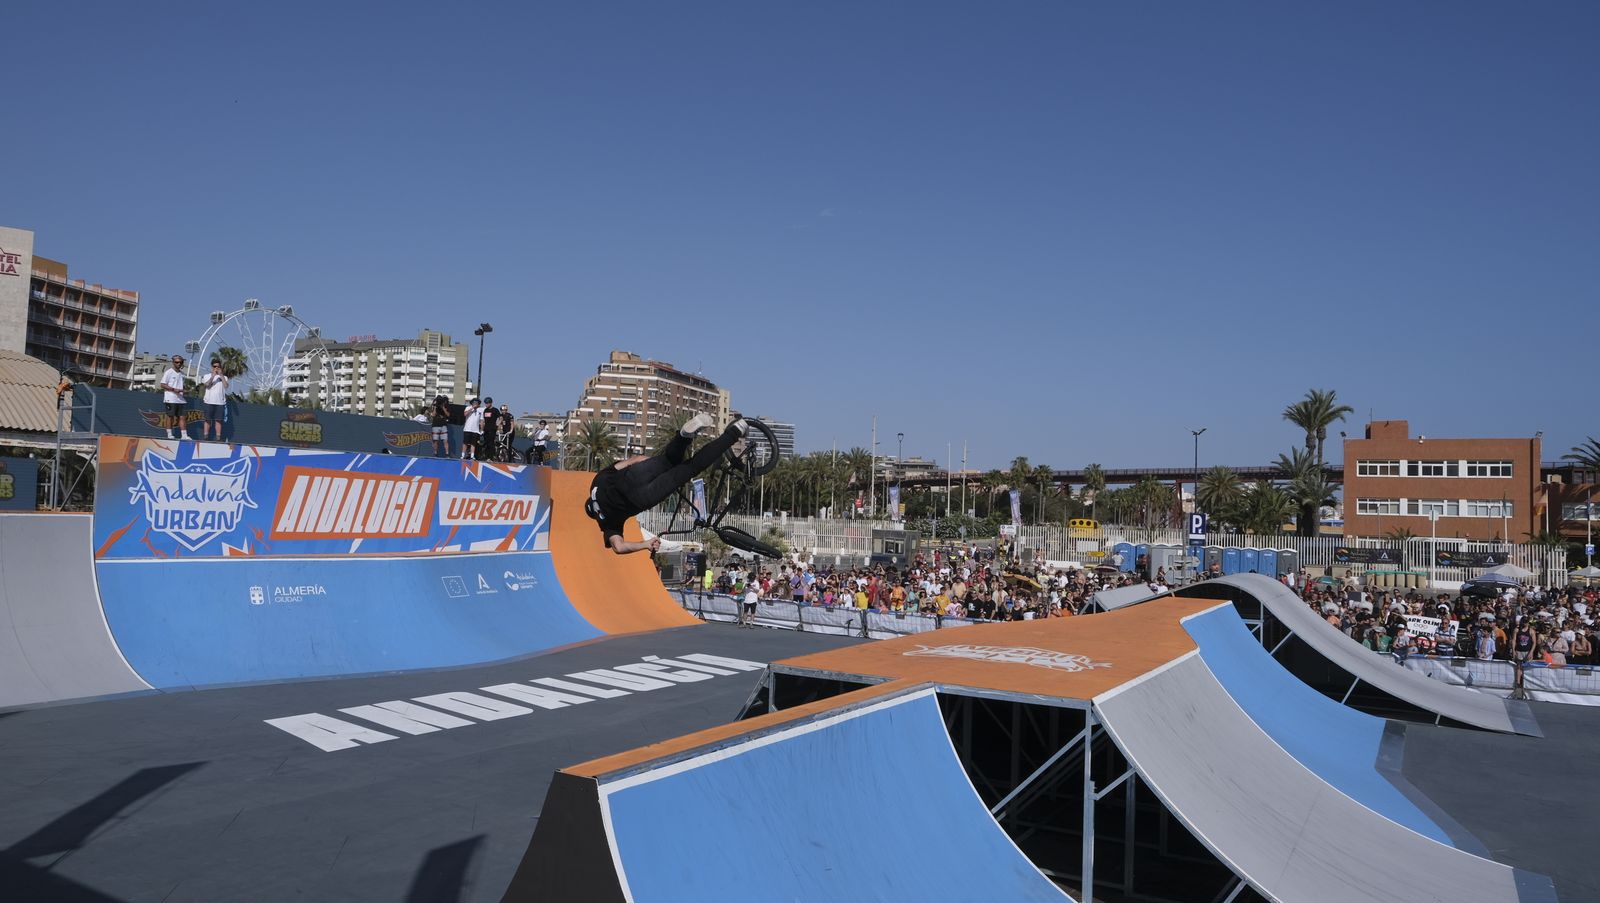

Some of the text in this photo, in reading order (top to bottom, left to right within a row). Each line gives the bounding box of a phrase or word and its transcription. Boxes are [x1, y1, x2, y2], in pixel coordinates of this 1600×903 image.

[280, 420, 322, 434] SUPER
[129, 470, 258, 506] Andalucía
[275, 474, 433, 534] ANDALUCÍA
[446, 497, 533, 521] URBAN
[153, 509, 236, 531] URBAN
[274, 584, 327, 596] ALMERÍA
[262, 652, 771, 754] ANDALUCÍA
